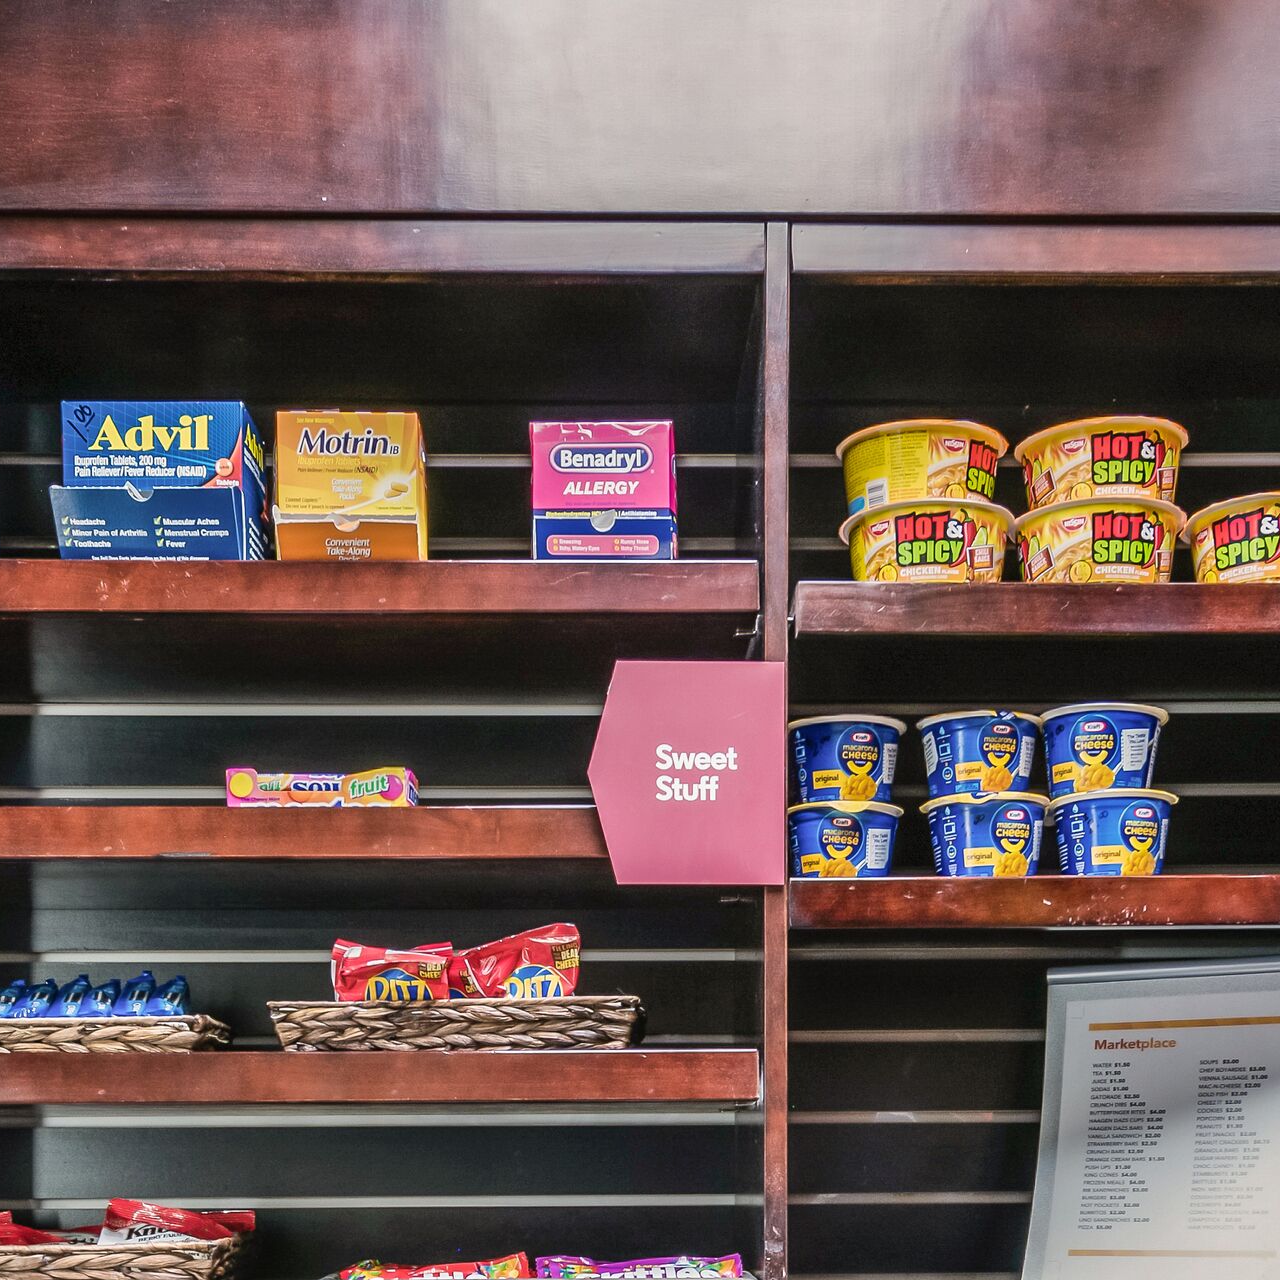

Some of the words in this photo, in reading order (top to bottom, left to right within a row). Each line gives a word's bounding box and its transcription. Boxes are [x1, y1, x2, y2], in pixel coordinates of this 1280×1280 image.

[88, 415, 210, 452] Advil
[298, 429, 389, 454] Motrin
[390, 445, 400, 455] IB
[1093, 434, 1144, 461] HOT
[1141, 441, 1156, 460] &
[74, 455, 108, 467] Ibuprofen
[109, 455, 138, 467] Tablets,
[139, 456, 153, 466] 200
[154, 457, 167, 467] mg
[297, 457, 334, 466] Ibuprofen
[335, 456, 361, 465] Tablets
[560, 449, 642, 473] Benadryl
[970, 443, 998, 476] HOT
[74, 467, 90, 477] Pain
[145, 467, 175, 477] Reducer
[176, 466, 207, 478] (NSAID)
[1094, 460, 1156, 484] SPICY
[563, 481, 639, 495] ALLERGY
[1095, 486, 1135, 495] CHICKEN
[70, 518, 106, 526] Headache
[163, 518, 196, 526] Muscular
[197, 518, 220, 526] Aches
[897, 514, 950, 542] HOT
[946, 520, 964, 538] &
[1094, 513, 1144, 541] HOT
[1140, 521, 1155, 540] &
[72, 529, 93, 537] Minor
[93, 529, 110, 537] Pain
[110, 529, 119, 537] of
[119, 529, 148, 537] Arthritis
[164, 529, 200, 537] Menstrual
[201, 529, 229, 538] Cramps
[1214, 512, 1263, 548] HOT
[1260, 516, 1280, 535] &
[73, 540, 112, 548] Toothache
[166, 540, 186, 548] Fever
[325, 538, 370, 547] Convenient
[326, 547, 371, 557] Take-Along
[897, 540, 963, 566] SPICY
[1093, 540, 1155, 564] SPICY
[1216, 535, 1280, 570] SPICY
[900, 567, 942, 577] CHICKEN
[1095, 566, 1135, 575] CHICKEN
[1220, 564, 1258, 581] CHICKEN
[656, 743, 739, 771] Sweet
[814, 774, 839, 783] original
[350, 774, 390, 799] fruit
[656, 774, 720, 802] Stuff
[555, 959, 580, 970] CHEESE
[1094, 1037, 1177, 1051] Marketplace
